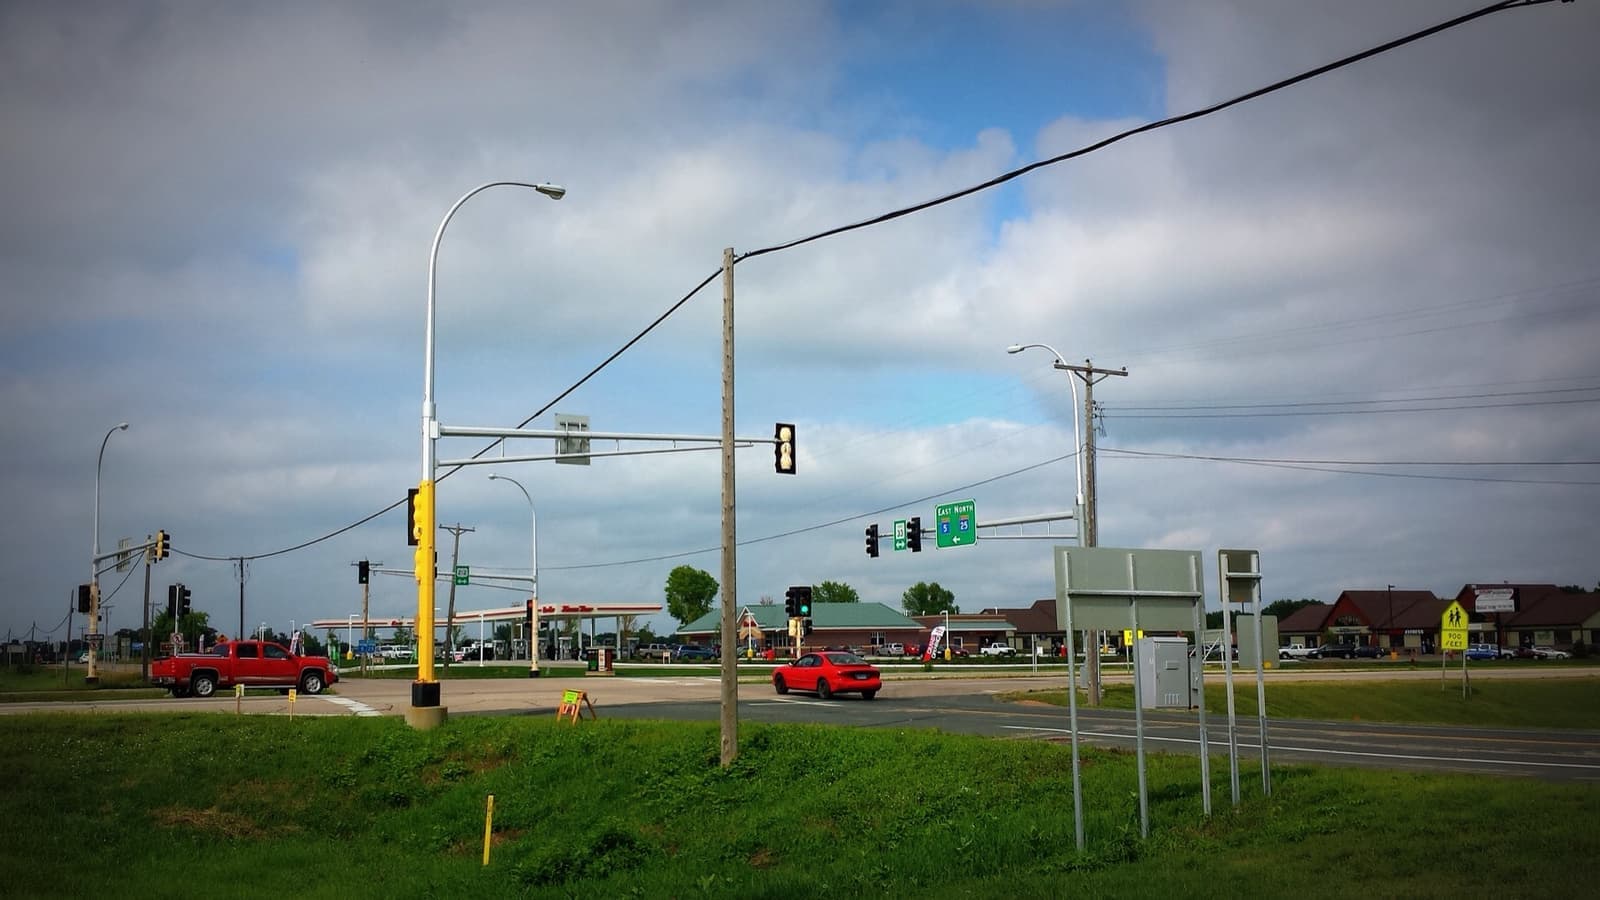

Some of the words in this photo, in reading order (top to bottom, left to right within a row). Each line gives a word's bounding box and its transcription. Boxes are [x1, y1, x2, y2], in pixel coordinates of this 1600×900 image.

[938, 508, 951, 516] EAST
[954, 505, 973, 513] NORTH
[943, 524, 948, 533] 5
[960, 521, 968, 530] 25
